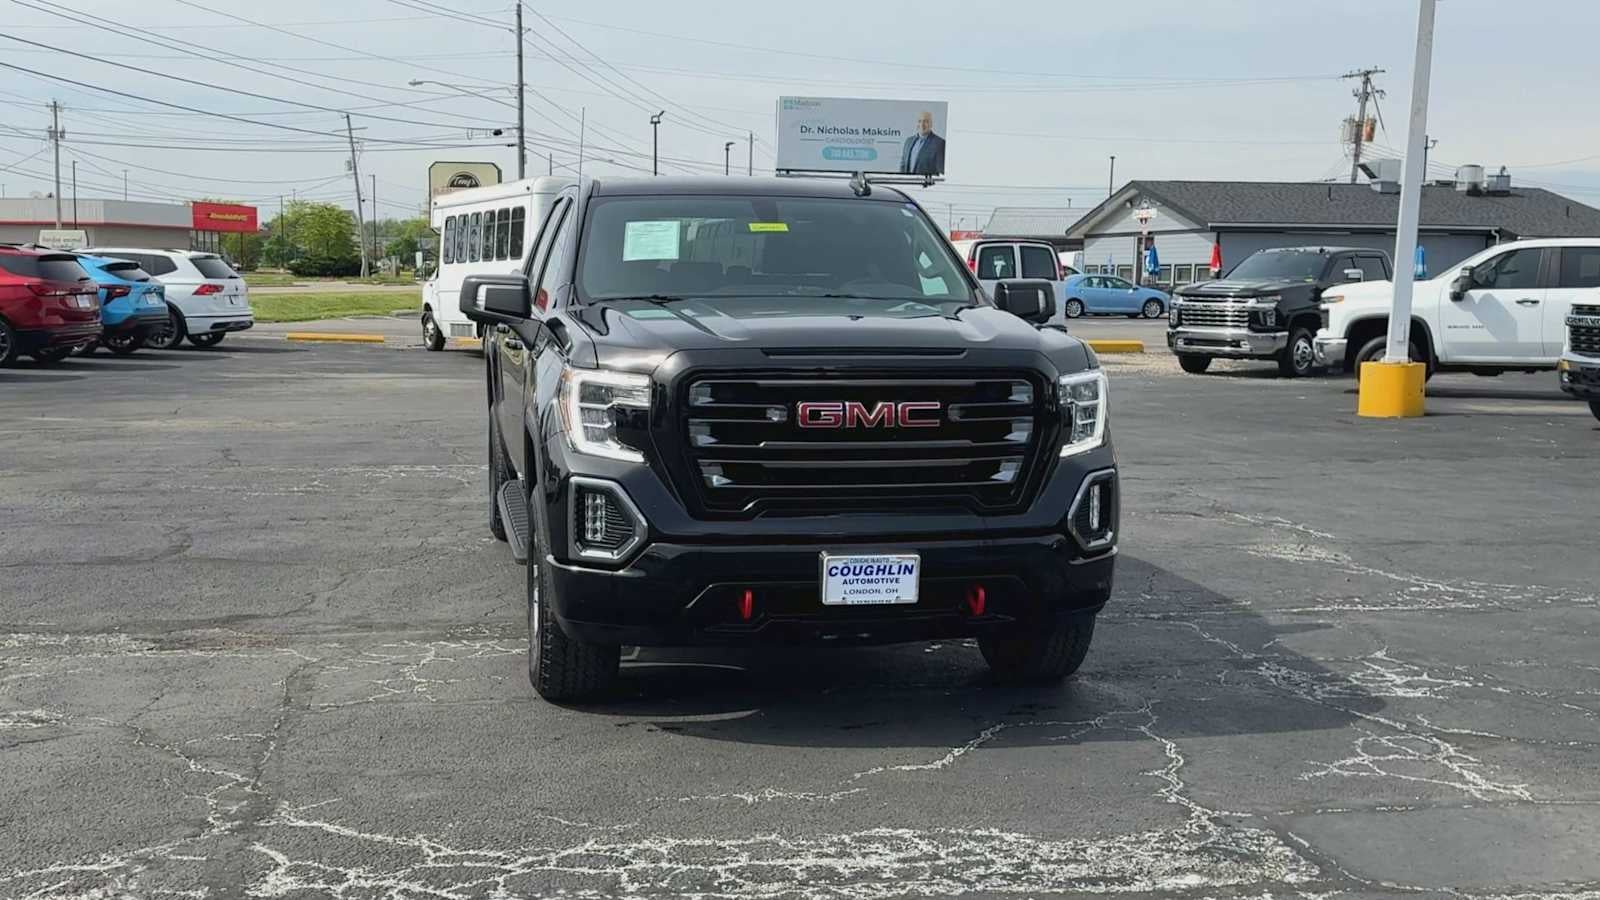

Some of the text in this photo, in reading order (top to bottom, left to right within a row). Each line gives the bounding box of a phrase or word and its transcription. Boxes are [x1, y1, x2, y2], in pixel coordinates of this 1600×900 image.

[800, 125, 902, 137] Dr. Nicholas Maksim
[797, 401, 941, 428] GMC
[828, 564, 914, 577] COUGHLIN
[842, 577, 901, 585] AUTOMOTIVE
